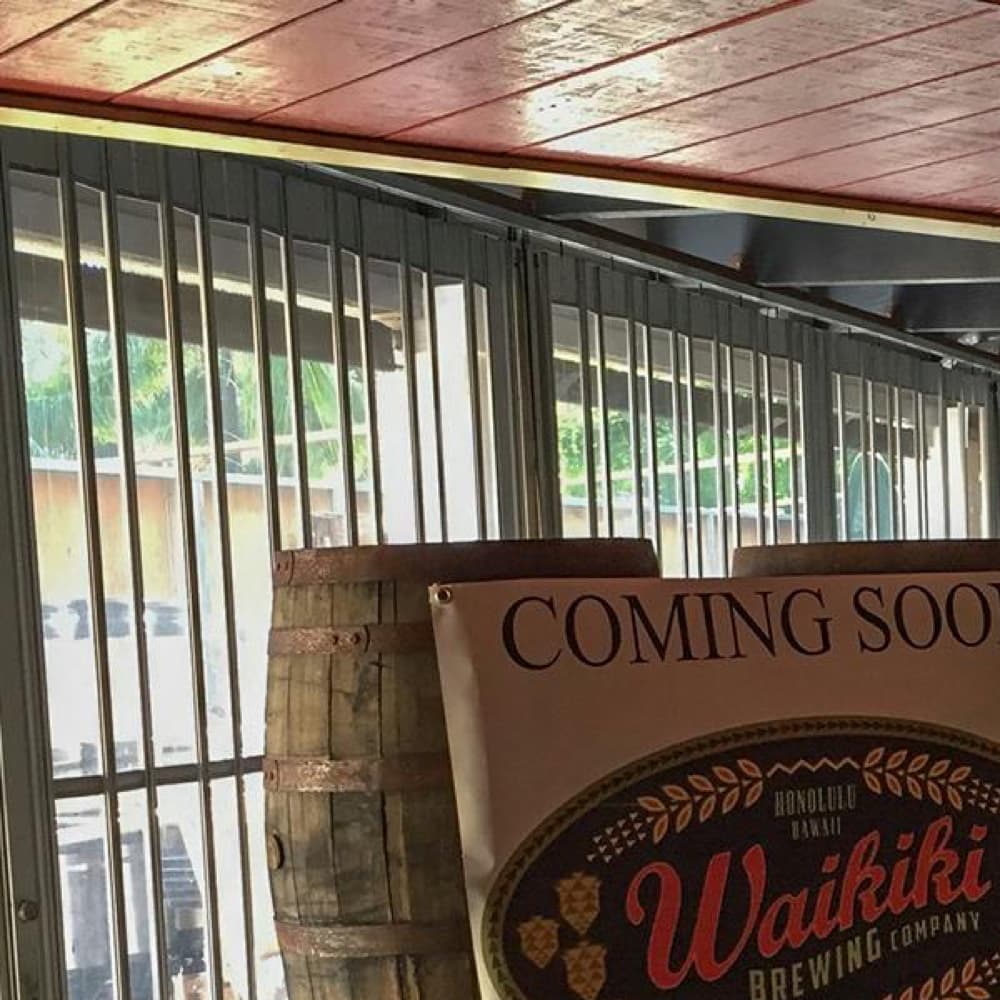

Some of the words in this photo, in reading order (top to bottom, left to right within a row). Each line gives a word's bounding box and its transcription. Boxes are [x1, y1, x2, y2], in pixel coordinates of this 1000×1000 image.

[502, 588, 833, 671] COMING
[775, 784, 856, 817] HONOLULU
[626, 815, 993, 991] Waikiki
[890, 911, 982, 952] COMPANY
